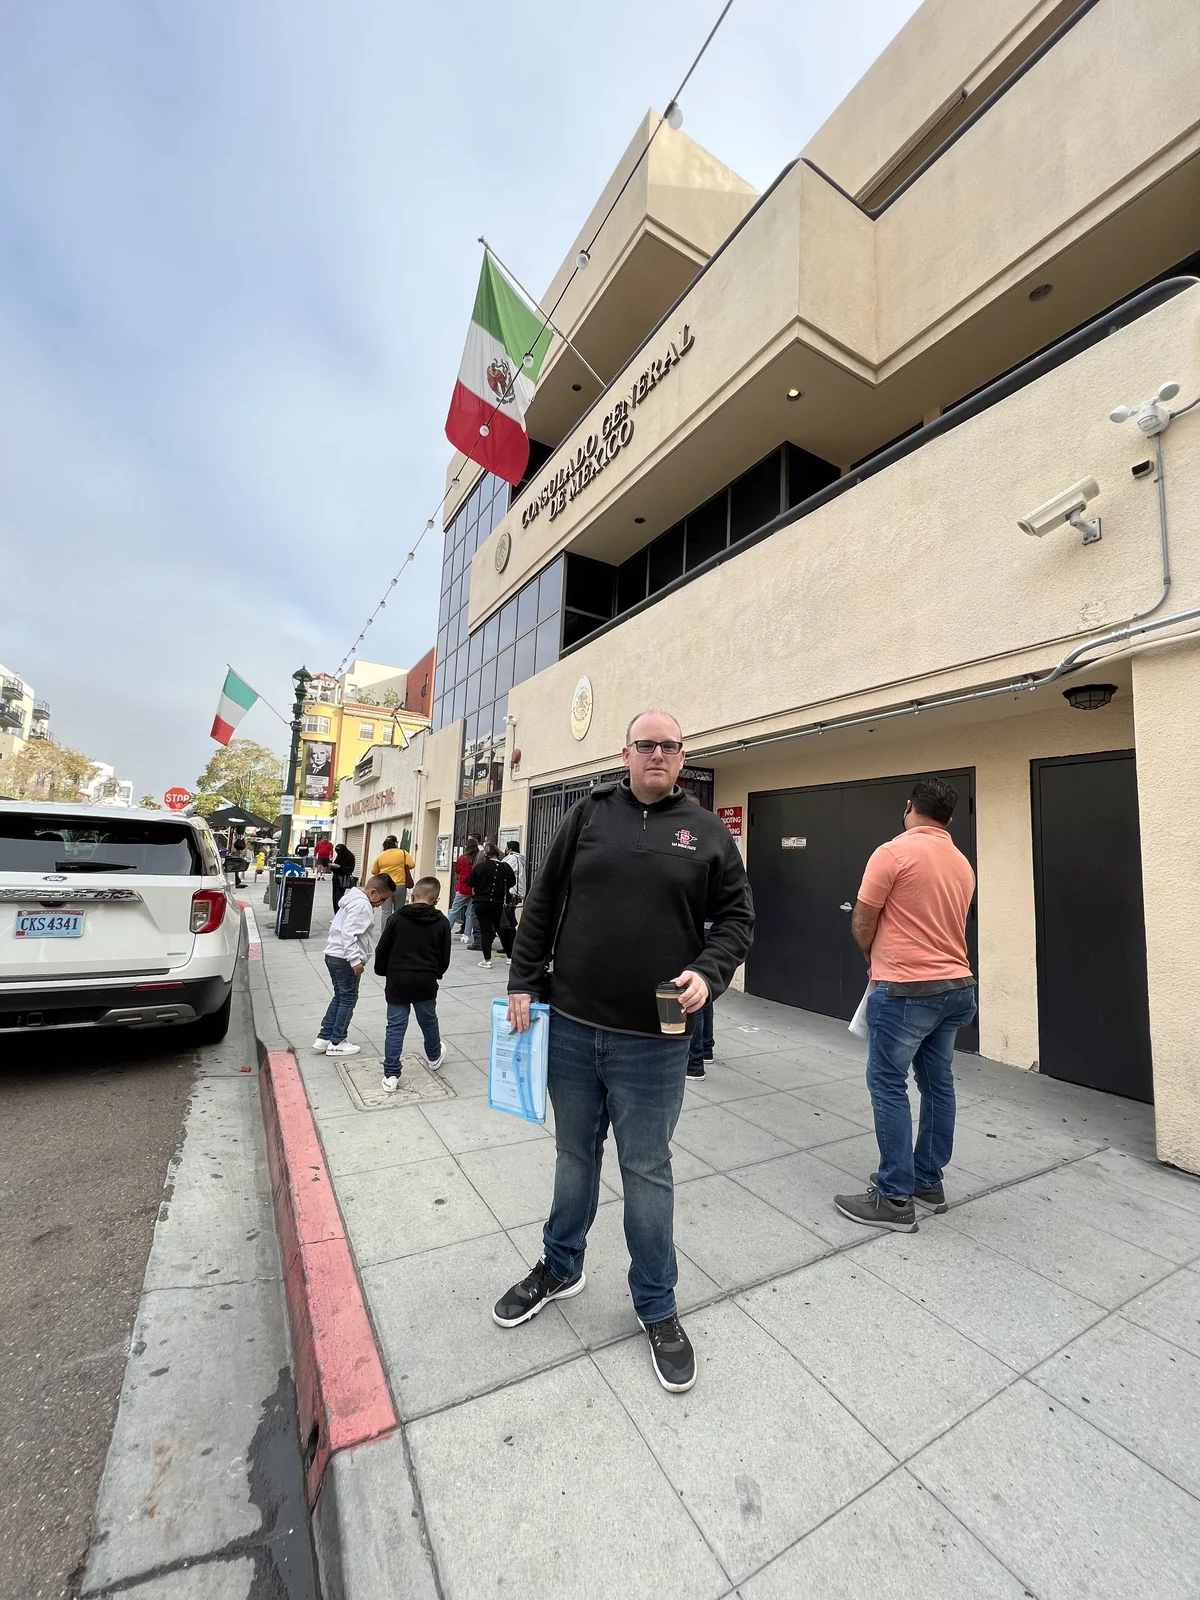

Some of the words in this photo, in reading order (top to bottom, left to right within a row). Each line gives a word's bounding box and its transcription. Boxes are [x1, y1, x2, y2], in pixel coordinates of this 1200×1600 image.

[521, 433, 599, 529] CONSULADO
[601, 323, 695, 440] GENERAL
[549, 488, 567, 522] DE
[165, 793, 190, 802] STOP
[724, 808, 734, 816] NO
[21, 917, 46, 931] CKS
[47, 917, 78, 931] 4341
